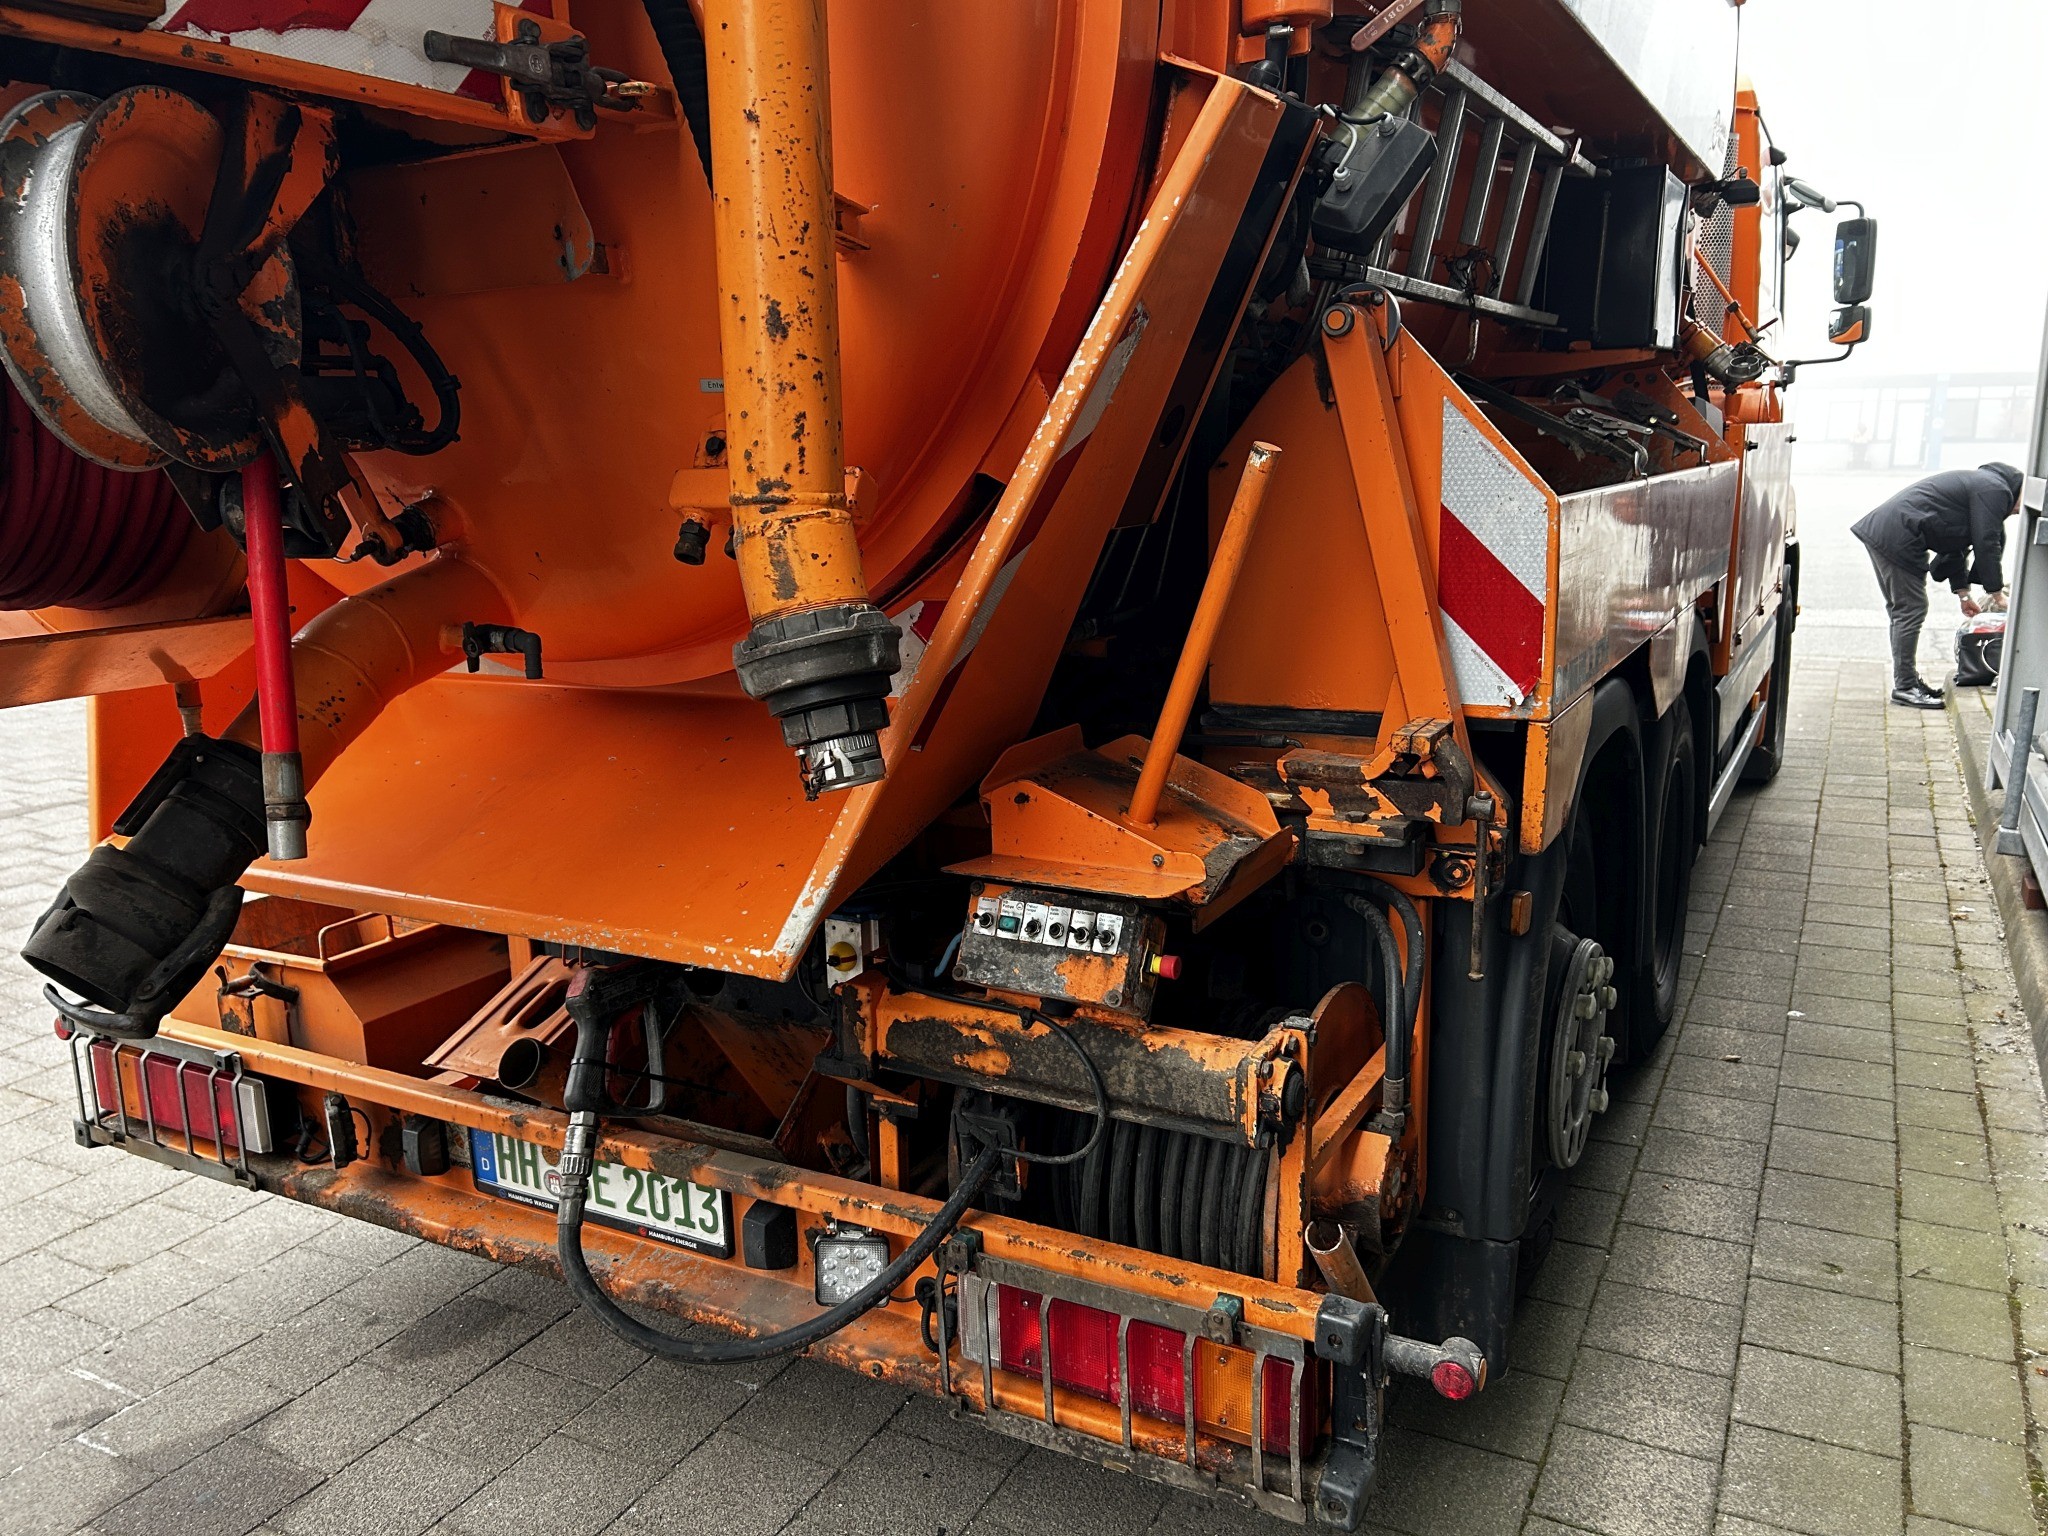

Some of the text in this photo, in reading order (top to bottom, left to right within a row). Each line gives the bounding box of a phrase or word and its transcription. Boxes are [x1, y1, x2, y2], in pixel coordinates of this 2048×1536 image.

[482, 1158, 490, 1171] D
[496, 1133, 719, 1233] HH E 2013
[507, 1193, 554, 1210] HAMBURG WASSER
[648, 1230, 697, 1249] HAMBURG ENERGIE
